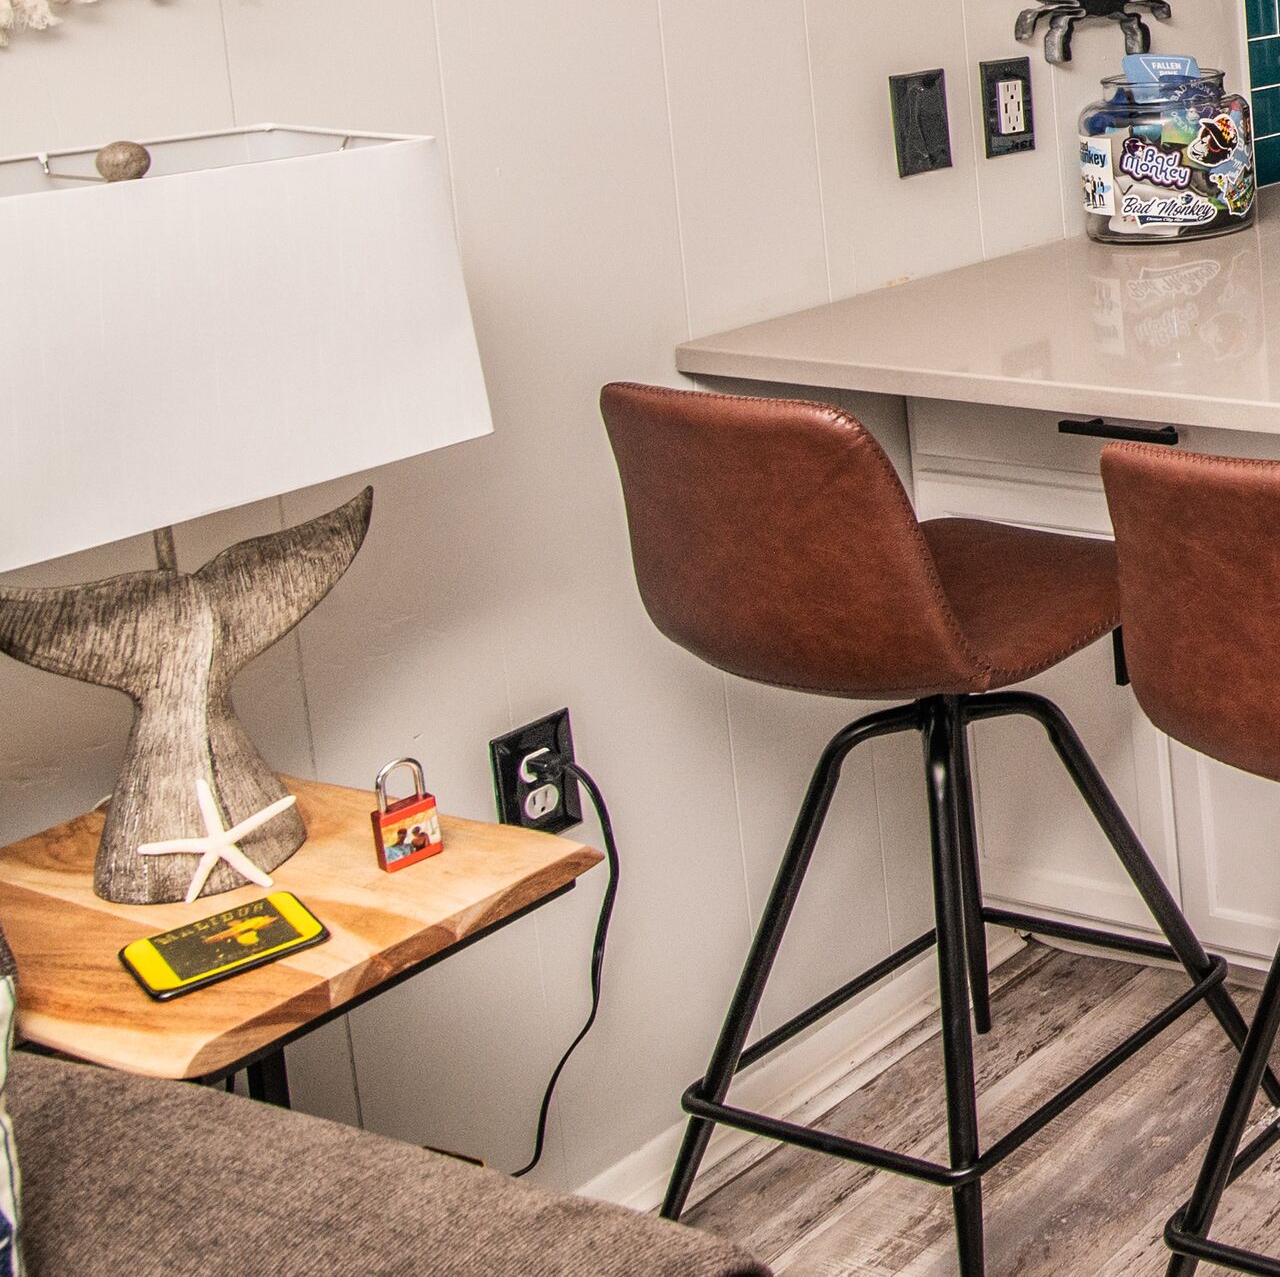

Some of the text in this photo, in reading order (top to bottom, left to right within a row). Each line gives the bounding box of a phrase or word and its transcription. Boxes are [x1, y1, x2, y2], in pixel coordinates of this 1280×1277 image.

[1151, 62, 1181, 70] FALLEN
[1143, 148, 1178, 167] Bad
[1123, 197, 1216, 221] Bad Monkey
